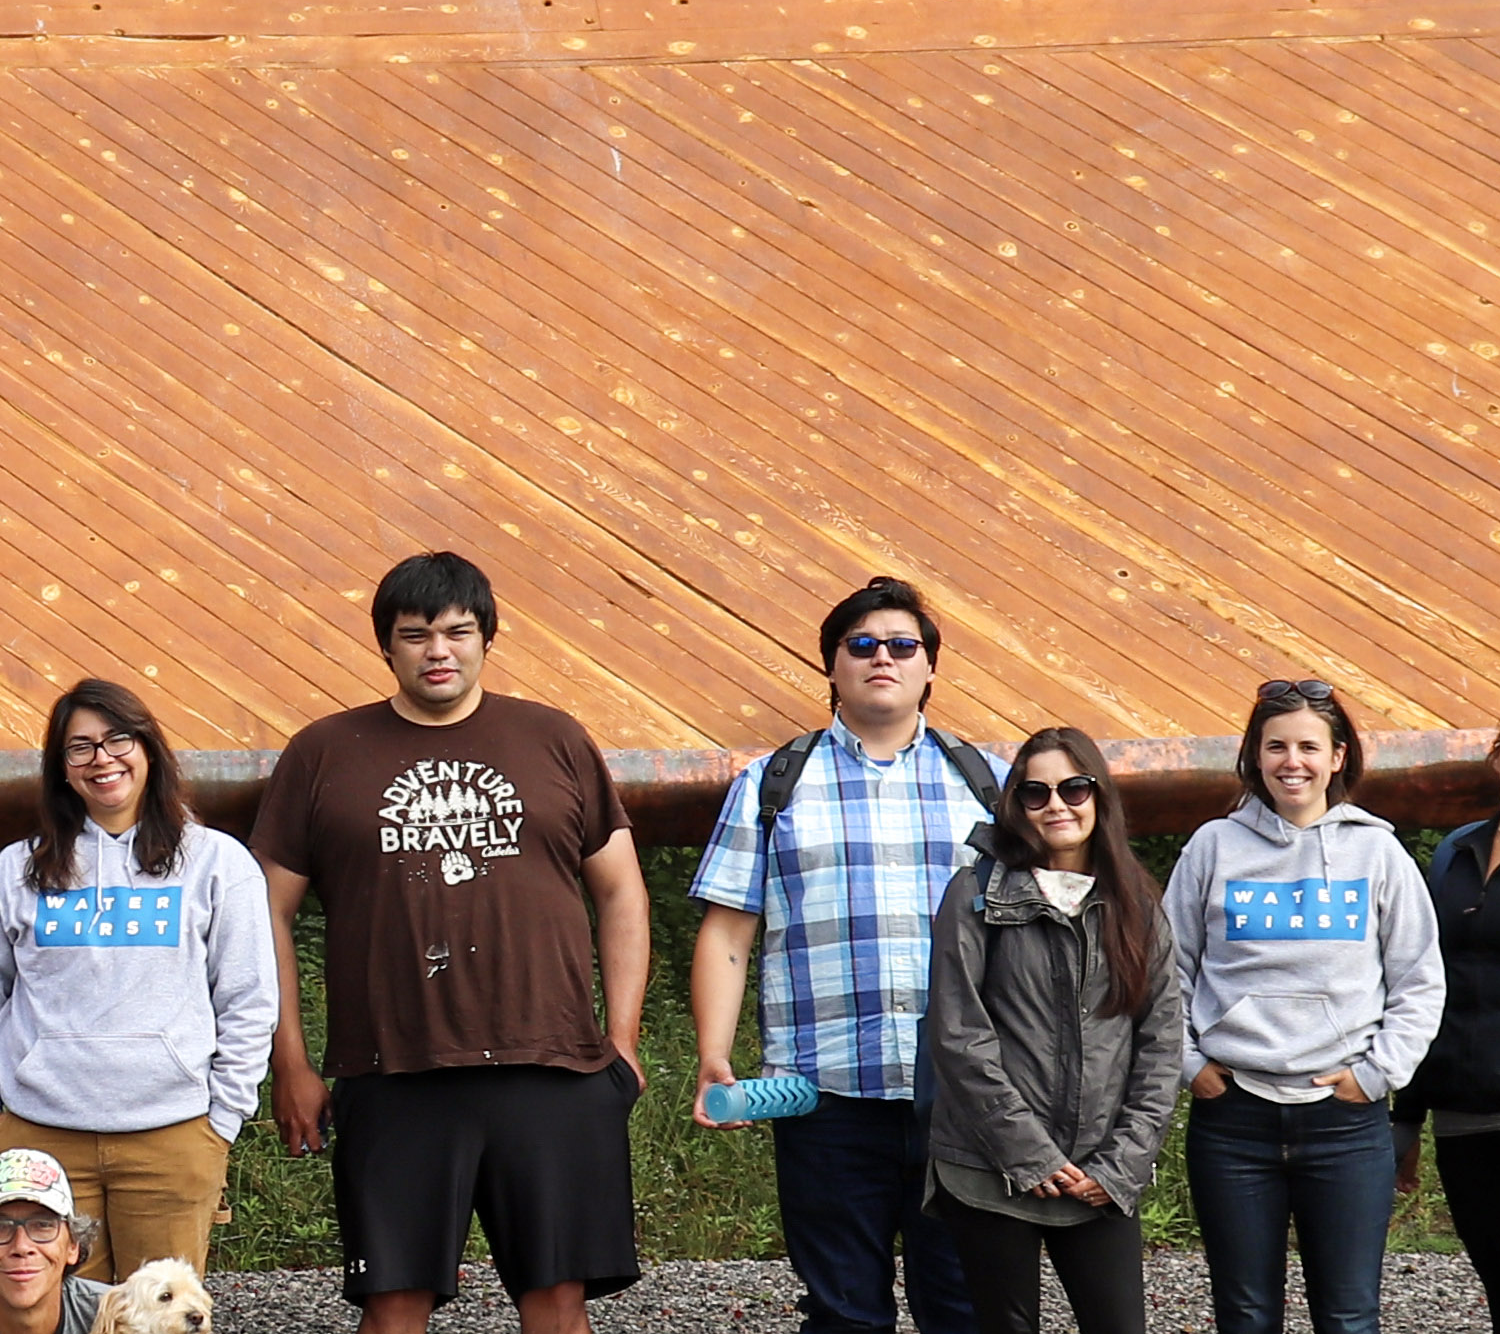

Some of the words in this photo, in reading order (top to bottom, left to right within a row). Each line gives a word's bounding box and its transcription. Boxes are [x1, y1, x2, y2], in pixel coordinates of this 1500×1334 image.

[378, 761, 524, 824] ADVENTURE
[380, 817, 524, 853] BRAVELY
[45, 895, 171, 911] WATER
[1233, 888, 1359, 905] WATER
[44, 920, 169, 936] FIRST
[1235, 914, 1360, 929] FIRST
